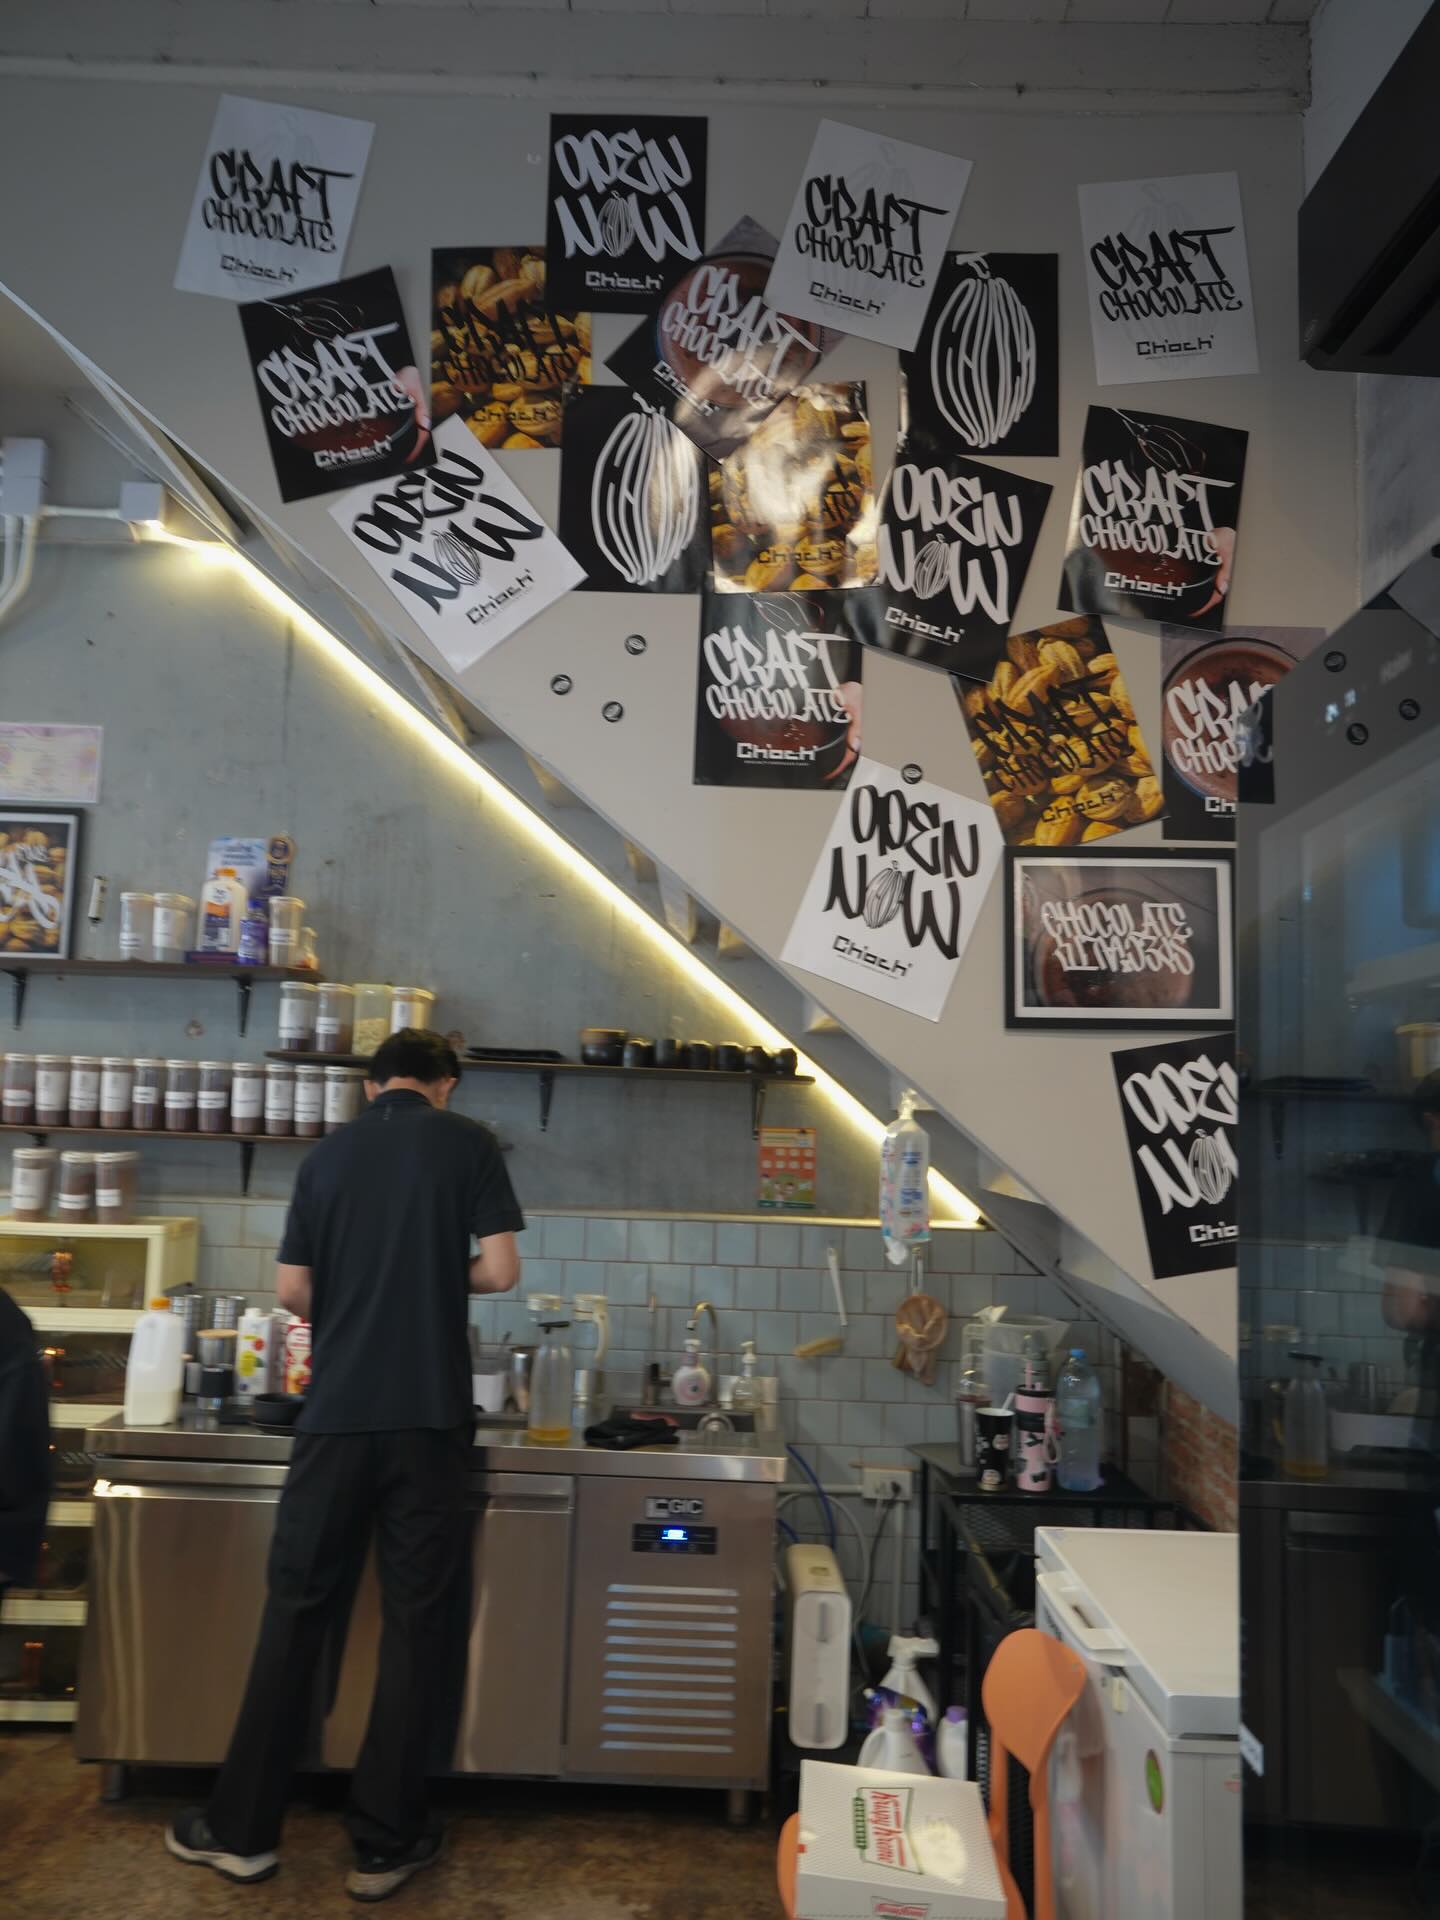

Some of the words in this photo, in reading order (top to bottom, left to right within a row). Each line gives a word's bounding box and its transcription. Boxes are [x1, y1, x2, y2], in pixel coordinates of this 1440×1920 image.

[209, 148, 355, 220] CRAFT
[554, 128, 692, 195] OPEN
[202, 198, 337, 253] CHOCOLATE
[554, 190, 703, 263] NOW
[805, 174, 950, 255] CRAFT
[795, 223, 925, 288] CHOCOLATE
[1090, 226, 1235, 290] CRAFT
[687, 265, 822, 381] CRAFT
[1099, 279, 1243, 322] CHOCOLATE
[257, 322, 406, 406] CRAFT
[660, 301, 778, 410] CHOCOLATE
[270, 380, 418, 438] CHOCOLATE
[353, 448, 484, 555] OPEN
[892, 463, 1023, 548] OPEN
[1083, 459, 1236, 531] CRAFT
[392, 493, 545, 616] NOW
[879, 523, 1011, 625] NOW
[1080, 514, 1223, 566] CHOCOLATE
[704, 624, 852, 690] CRAFT
[705, 683, 853, 723] CHOCOLATE
[1166, 677, 1276, 741] CRA
[852, 785, 979, 879] OPEN
[823, 846, 960, 960] NOW
[1040, 901, 1194, 939] CHOCOLATE
